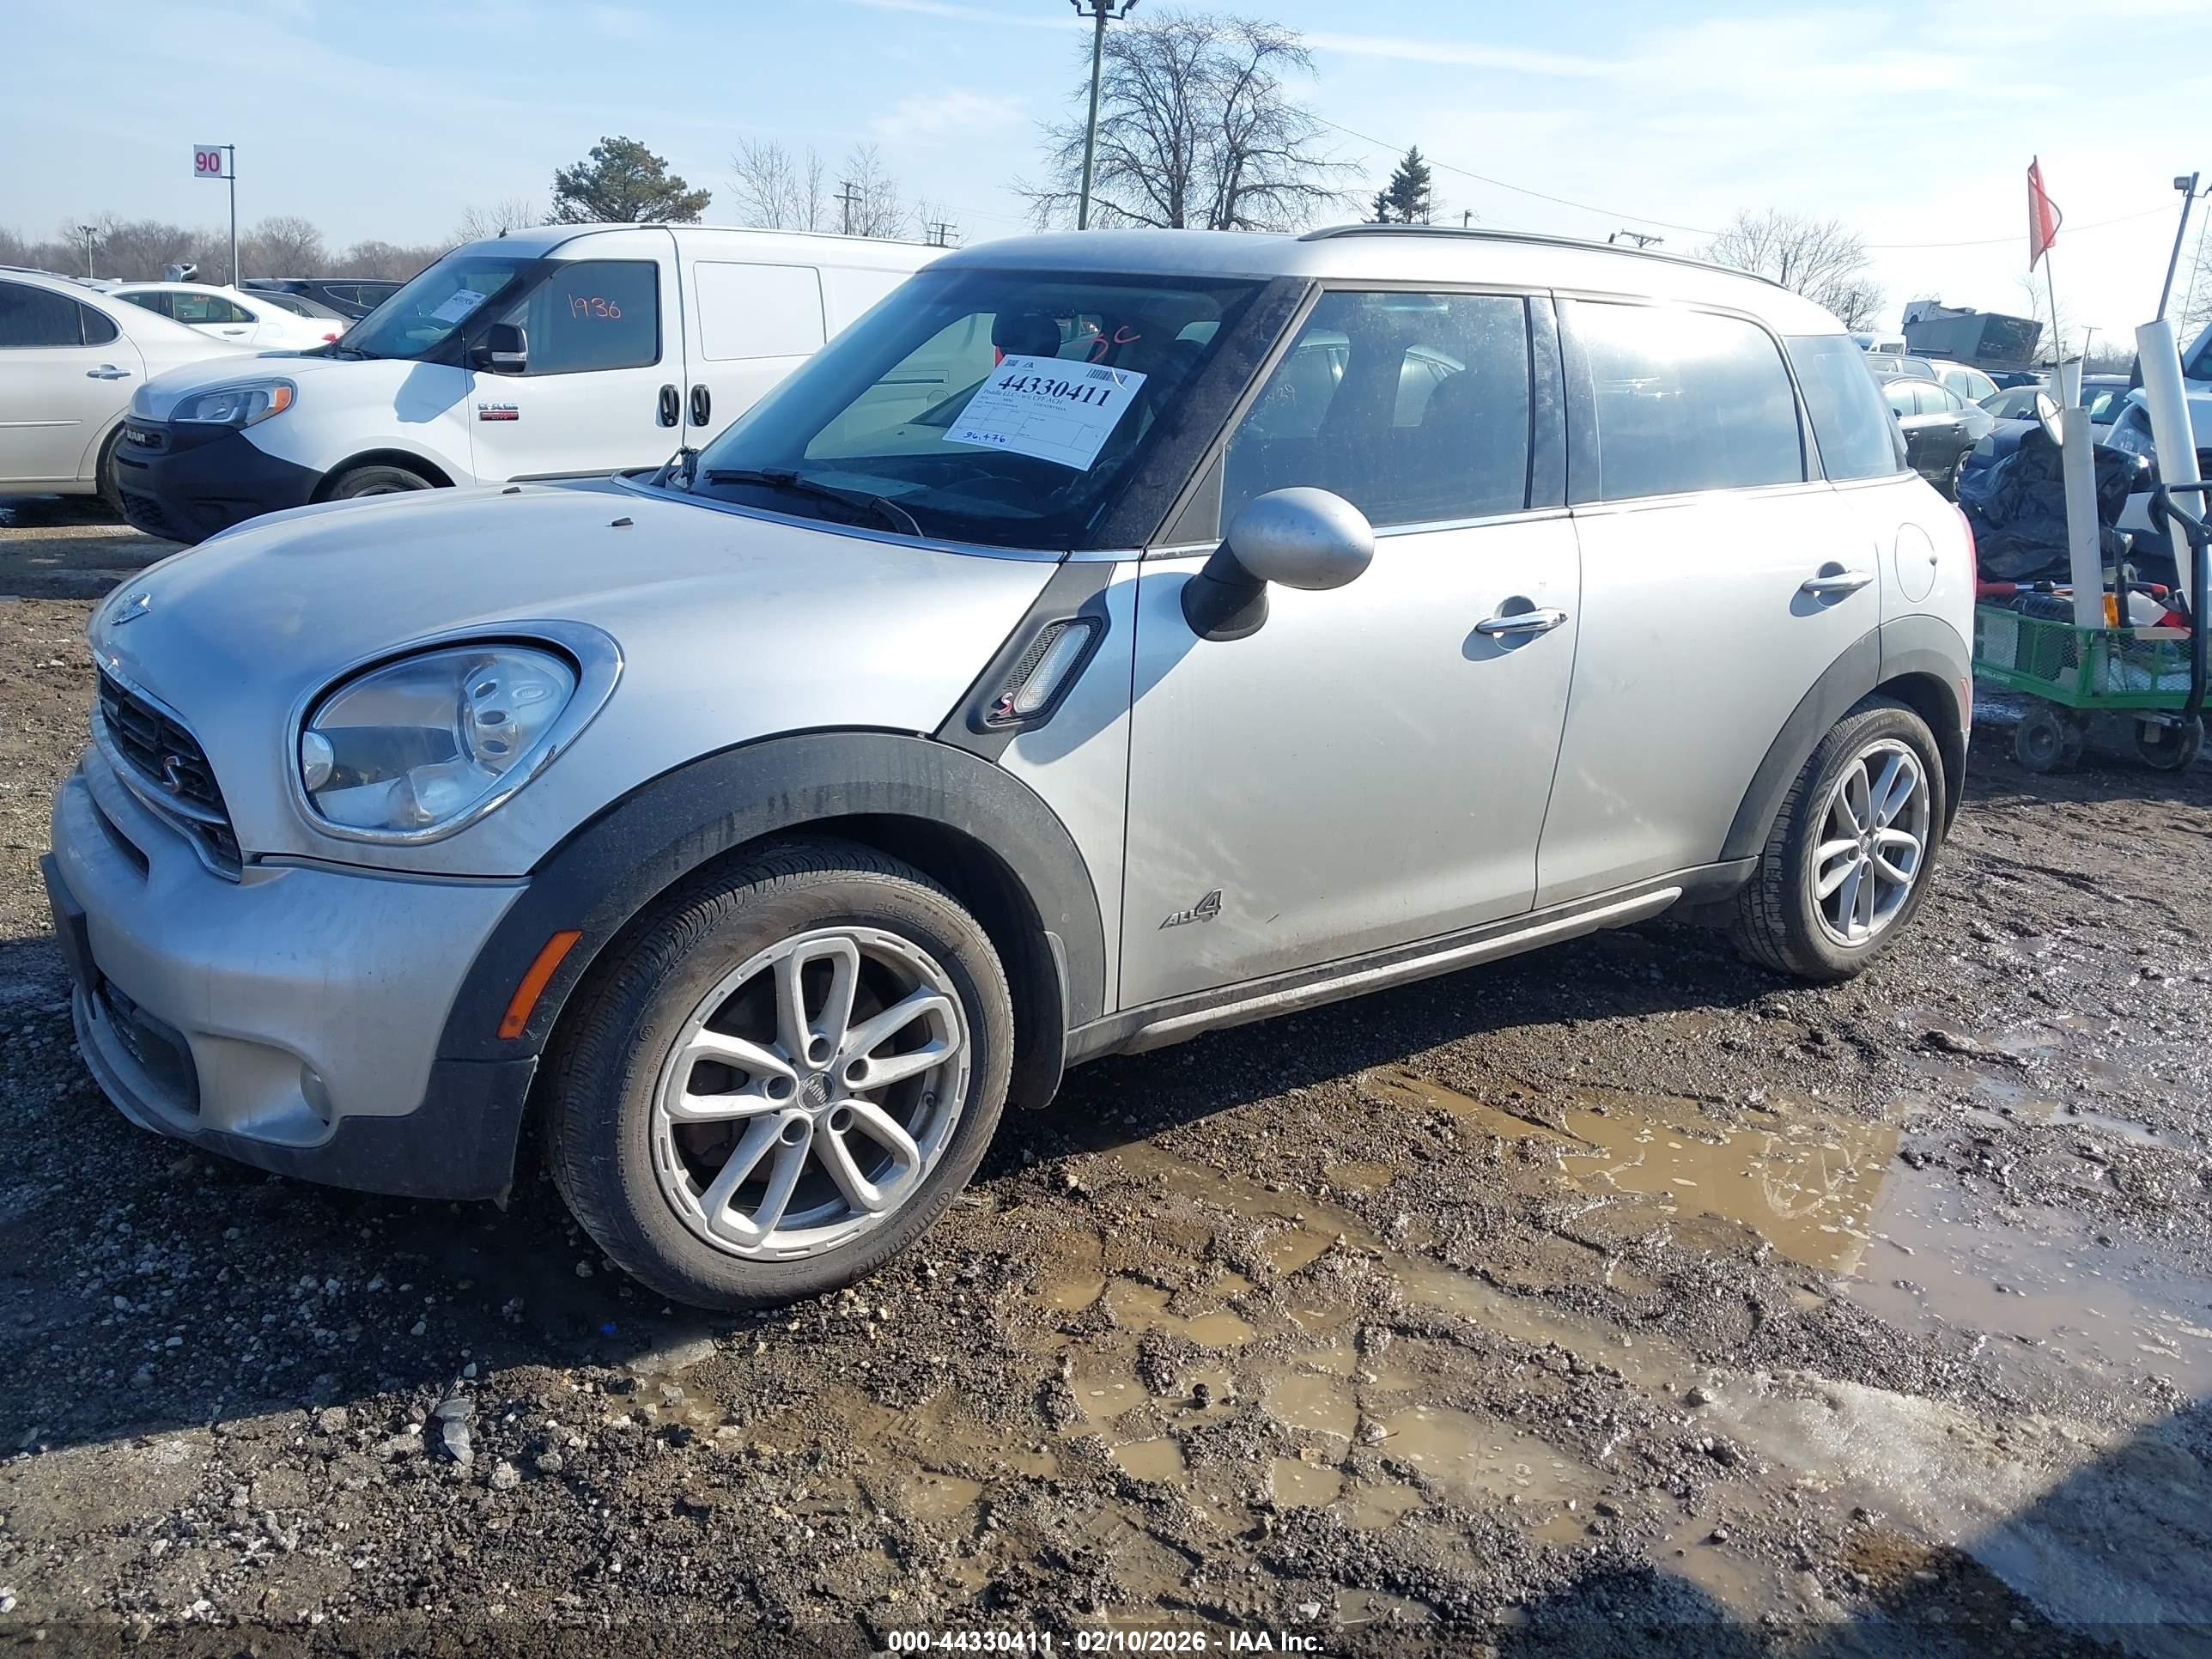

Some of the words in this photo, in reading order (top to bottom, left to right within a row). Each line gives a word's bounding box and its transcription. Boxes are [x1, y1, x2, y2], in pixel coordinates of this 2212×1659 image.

[196, 152, 220, 172] 90
[568, 294, 621, 319] 1936
[998, 374, 1111, 406] 44330411
[806, 1079, 829, 1104] MINI
